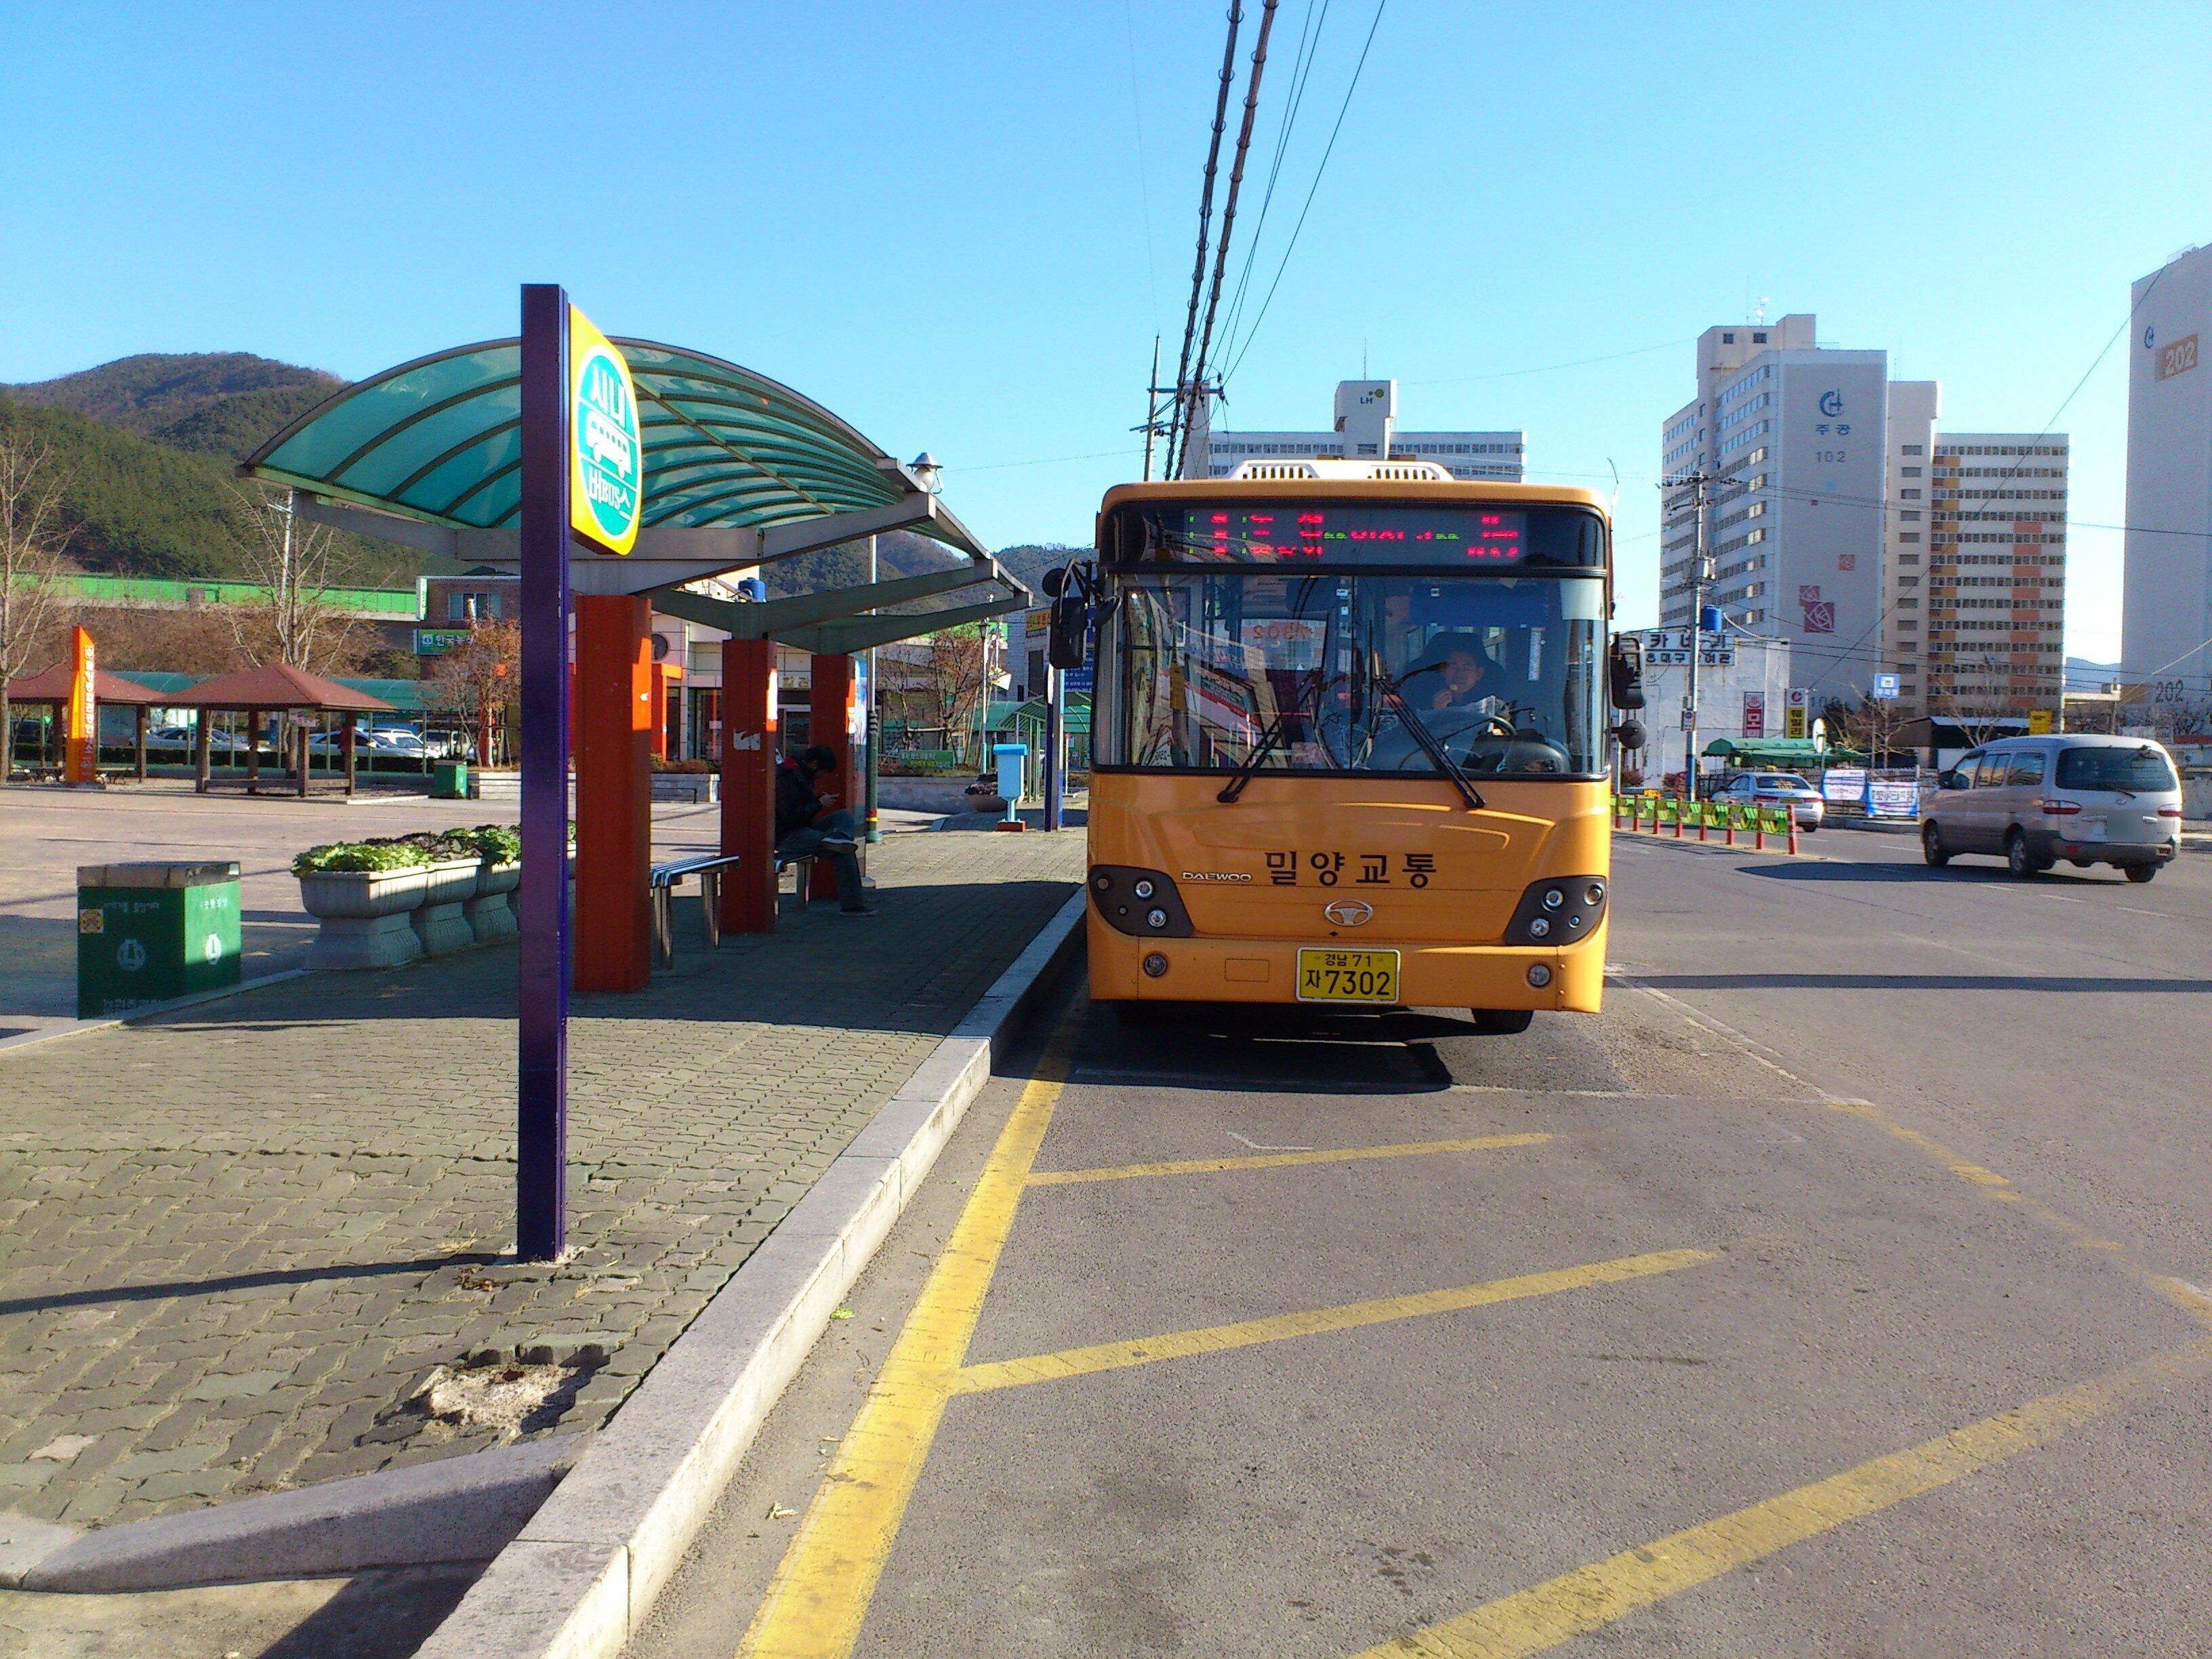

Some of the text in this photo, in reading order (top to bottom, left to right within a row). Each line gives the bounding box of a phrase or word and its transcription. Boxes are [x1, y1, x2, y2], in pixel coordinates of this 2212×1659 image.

[2165, 341, 2194, 375] 202
[590, 363, 626, 429] 시내
[1815, 424, 1851, 436] 주공
[1816, 451, 1846, 463] 102
[2156, 679, 2184, 703] 202
[1182, 872, 1252, 882] DAEWOO
[1265, 851, 1437, 888] 밀양교통
[1324, 954, 1372, 967] 경남 71
